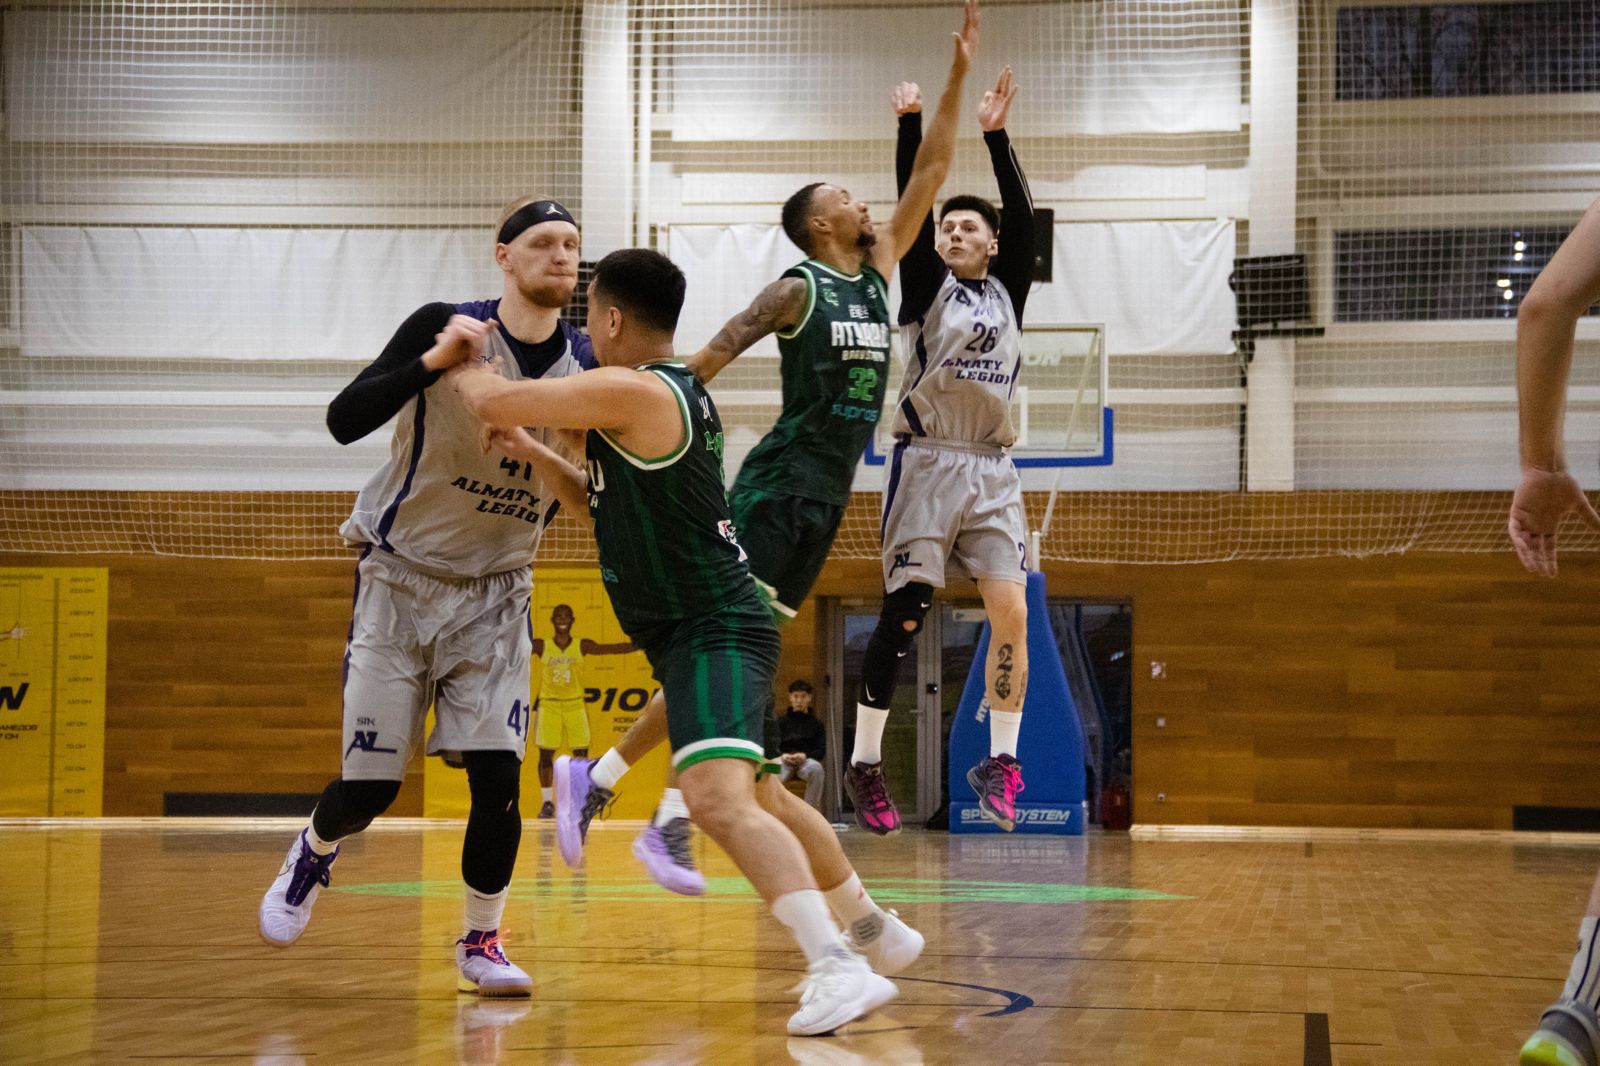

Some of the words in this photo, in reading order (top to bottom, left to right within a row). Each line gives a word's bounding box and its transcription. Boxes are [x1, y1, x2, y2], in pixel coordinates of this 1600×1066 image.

[965, 322, 998, 354] 26
[941, 358, 1003, 371] AMATY
[848, 367, 878, 401] 32
[500, 457, 532, 481] 41
[451, 477, 540, 507] ALMATY
[961, 808, 1071, 823] SPOYSTEM
